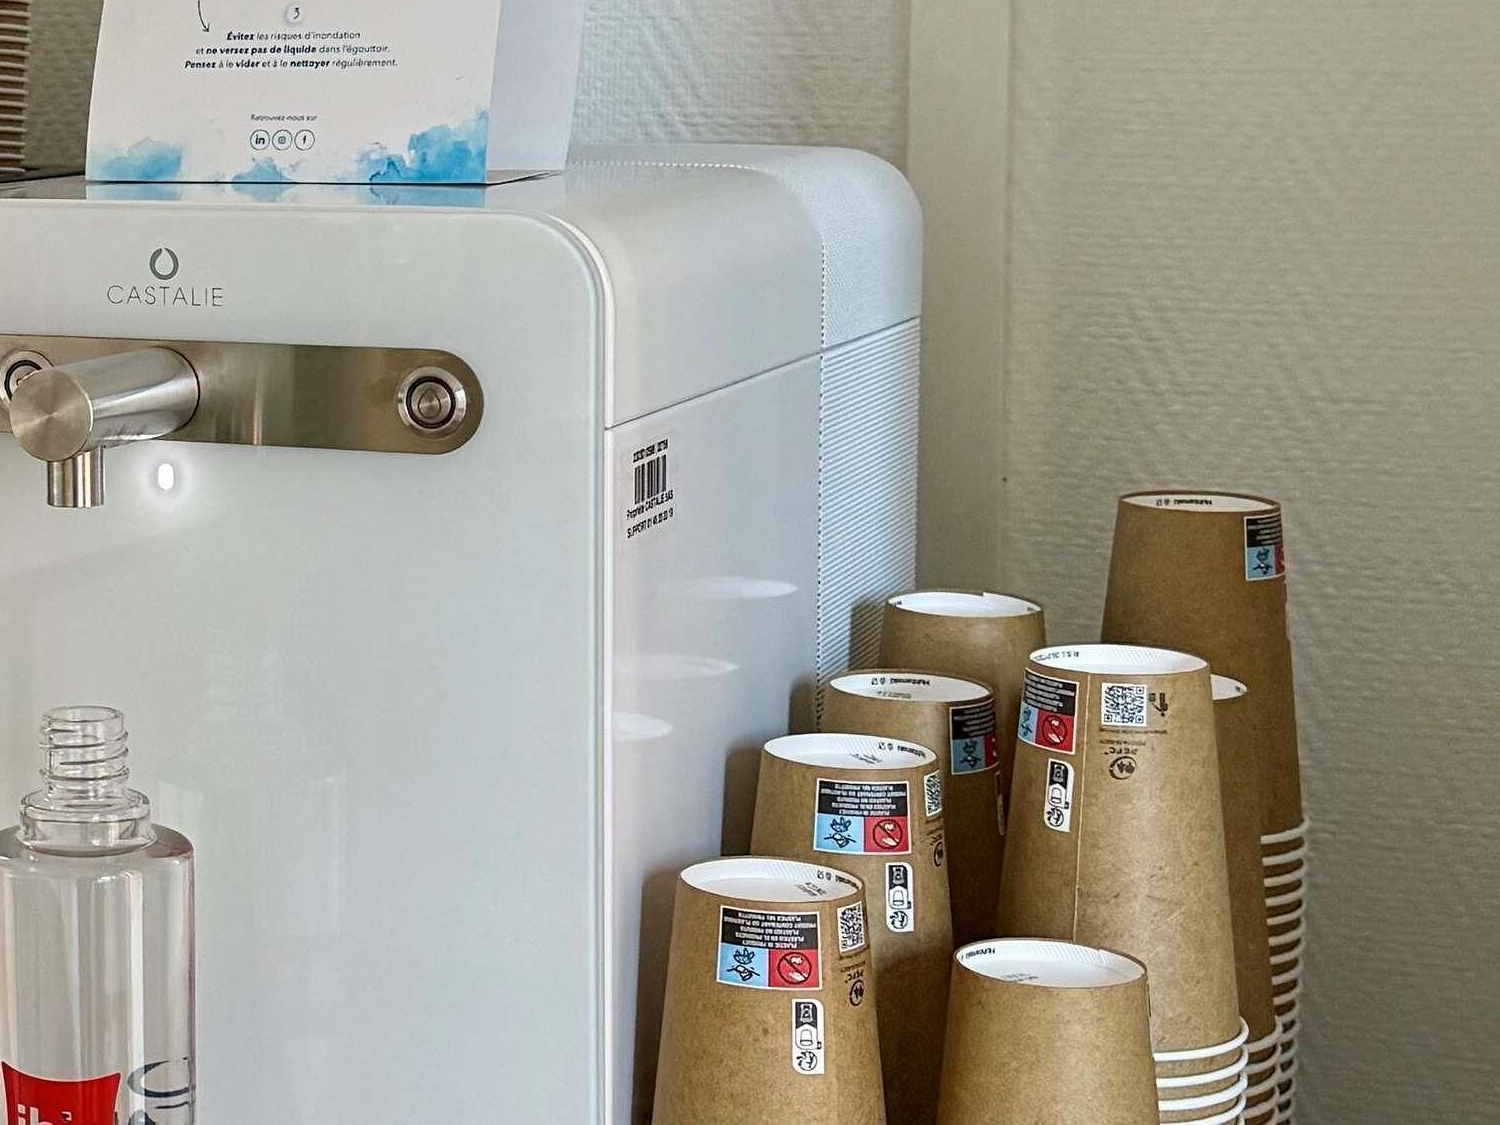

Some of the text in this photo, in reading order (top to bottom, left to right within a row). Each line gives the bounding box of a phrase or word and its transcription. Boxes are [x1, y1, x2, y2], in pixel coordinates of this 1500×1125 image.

[293, 7, 300, 19] 3
[226, 30, 254, 41] Évitez
[256, 32, 269, 40] les
[270, 32, 302, 41] risques
[251, 46, 267, 55] pas
[270, 45, 282, 53] de
[283, 44, 317, 55] liquide
[319, 45, 341, 53] dans
[184, 60, 216, 68] Pensez
[236, 59, 260, 68] vider
[290, 59, 330, 69] nettoyer
[107, 284, 223, 307] CASTALIE
